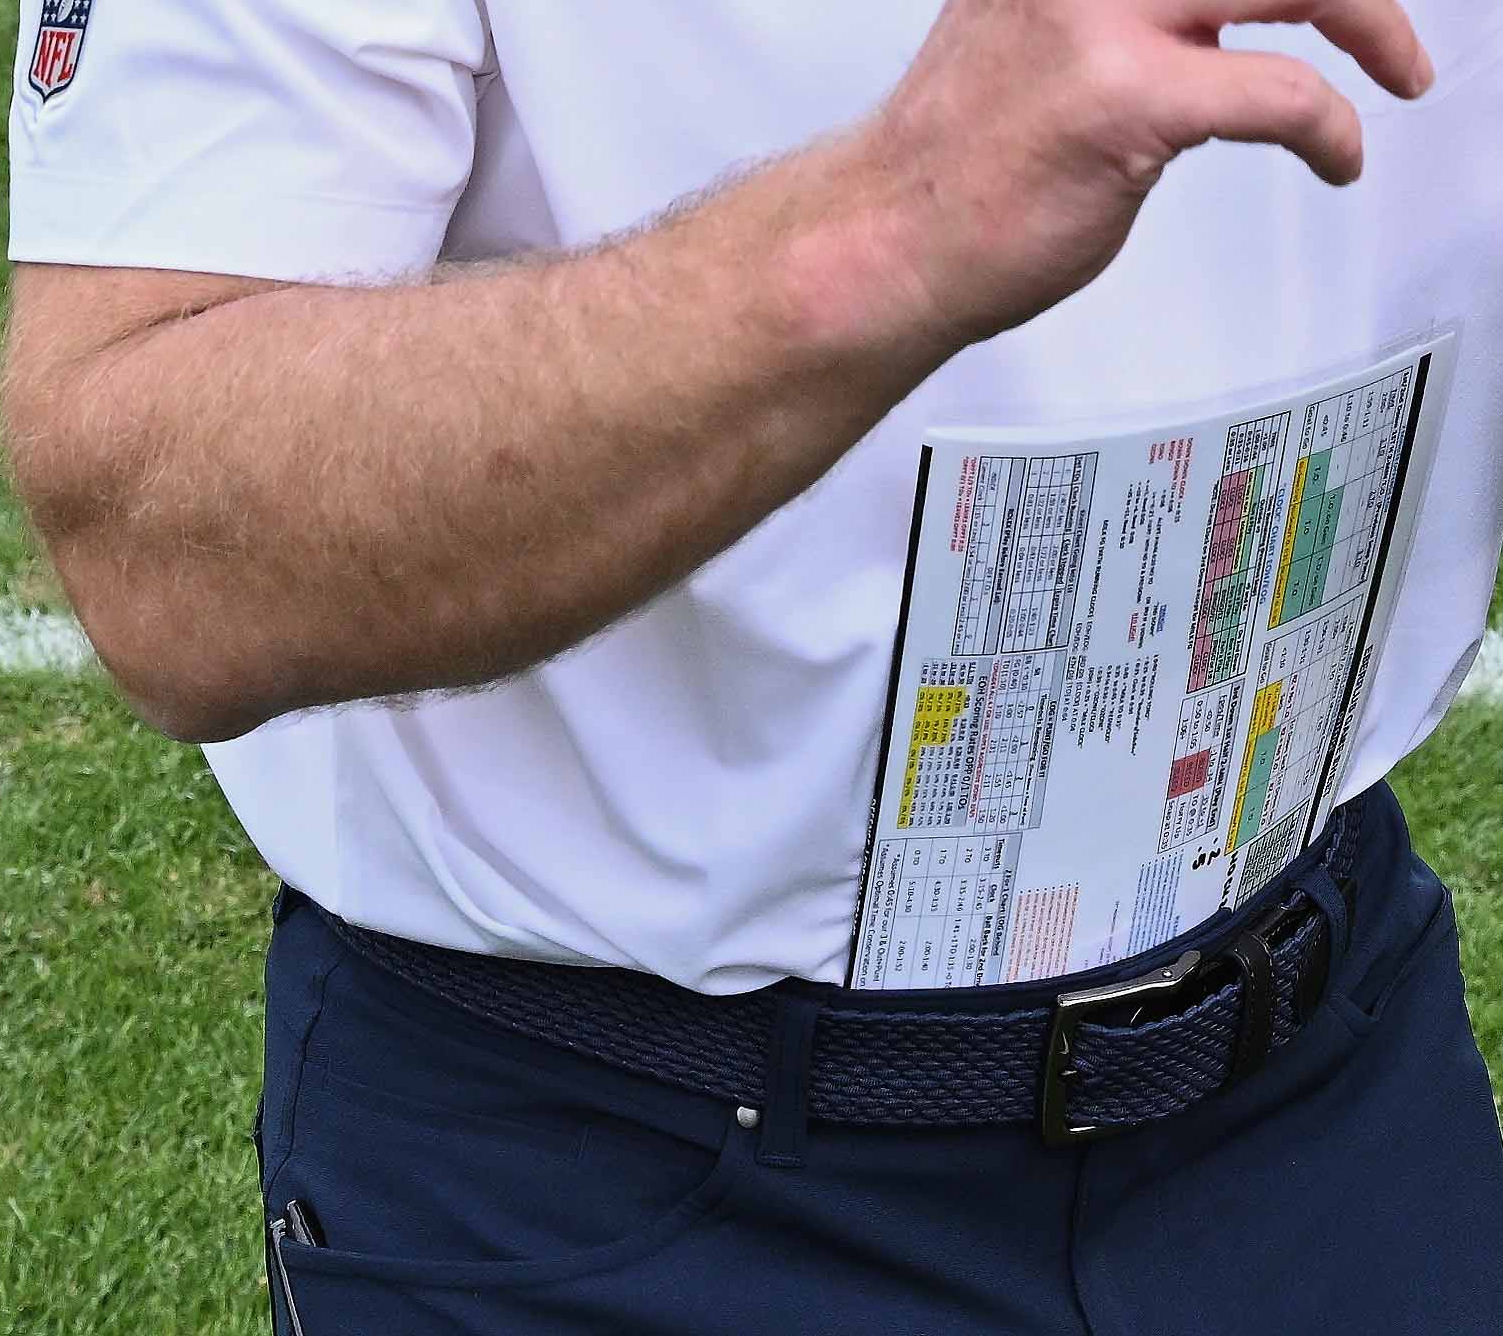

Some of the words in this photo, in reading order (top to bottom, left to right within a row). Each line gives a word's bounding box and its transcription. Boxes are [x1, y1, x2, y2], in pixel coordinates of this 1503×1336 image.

[33, 29, 76, 89] NFL
[1305, 405, 1315, 425] Goal
[1272, 482, 1287, 524] "CLOCK"
[1022, 517, 1030, 530] less
[1034, 516, 1042, 529] less
[1044, 516, 1052, 529] less
[1267, 525, 1278, 556] CHART
[1262, 641, 1272, 663] Goal
[976, 675, 988, 694] EOH
[1231, 685, 1240, 700] 3rd
[969, 696, 985, 728] Scoring
[1036, 693, 1047, 724] Timeouts
[1227, 700, 1237, 725] Down
[966, 730, 979, 755] Rates
[1224, 727, 1232, 740] 1st
[1336, 713, 1355, 756] GAME
[1029, 726, 1042, 761] Remaining
[1221, 739, 1231, 759] Half
[962, 756, 974, 774] OPP
[959, 775, 971, 790] 0/1
[956, 793, 968, 810] TOs
[1190, 793, 1199, 807] TO
[1210, 785, 1222, 808] (Play
[1164, 799, 1175, 821] Snap
[1174, 801, 1186, 827] Hurry
[1208, 807, 1218, 828] End)
[1172, 825, 1181, 840] Up
[1185, 817, 1194, 837] 0:35
[1160, 830, 1170, 850] 0:35
[912, 856, 919, 865] TO
[938, 854, 946, 864] TO
[964, 853, 972, 863] TO
[982, 852, 990, 862] TO
[992, 838, 1005, 869] Timeouts
[870, 880, 884, 908] Optimal
[884, 889, 894, 906] 0:45
[904, 881, 916, 912] 5:10-4:30
[987, 883, 997, 902] Clock
[868, 909, 878, 927] Time
[882, 908, 891, 918] for
[984, 915, 992, 928] Ball
[880, 920, 888, 931] our
[981, 929, 990, 945] Back
[991, 931, 1002, 956] Behind
[860, 929, 875, 975] Conservation
[979, 946, 987, 956] for
[872, 947, 884, 982] Out+Punt
[977, 958, 985, 971] 2nd
[859, 977, 866, 986] on
